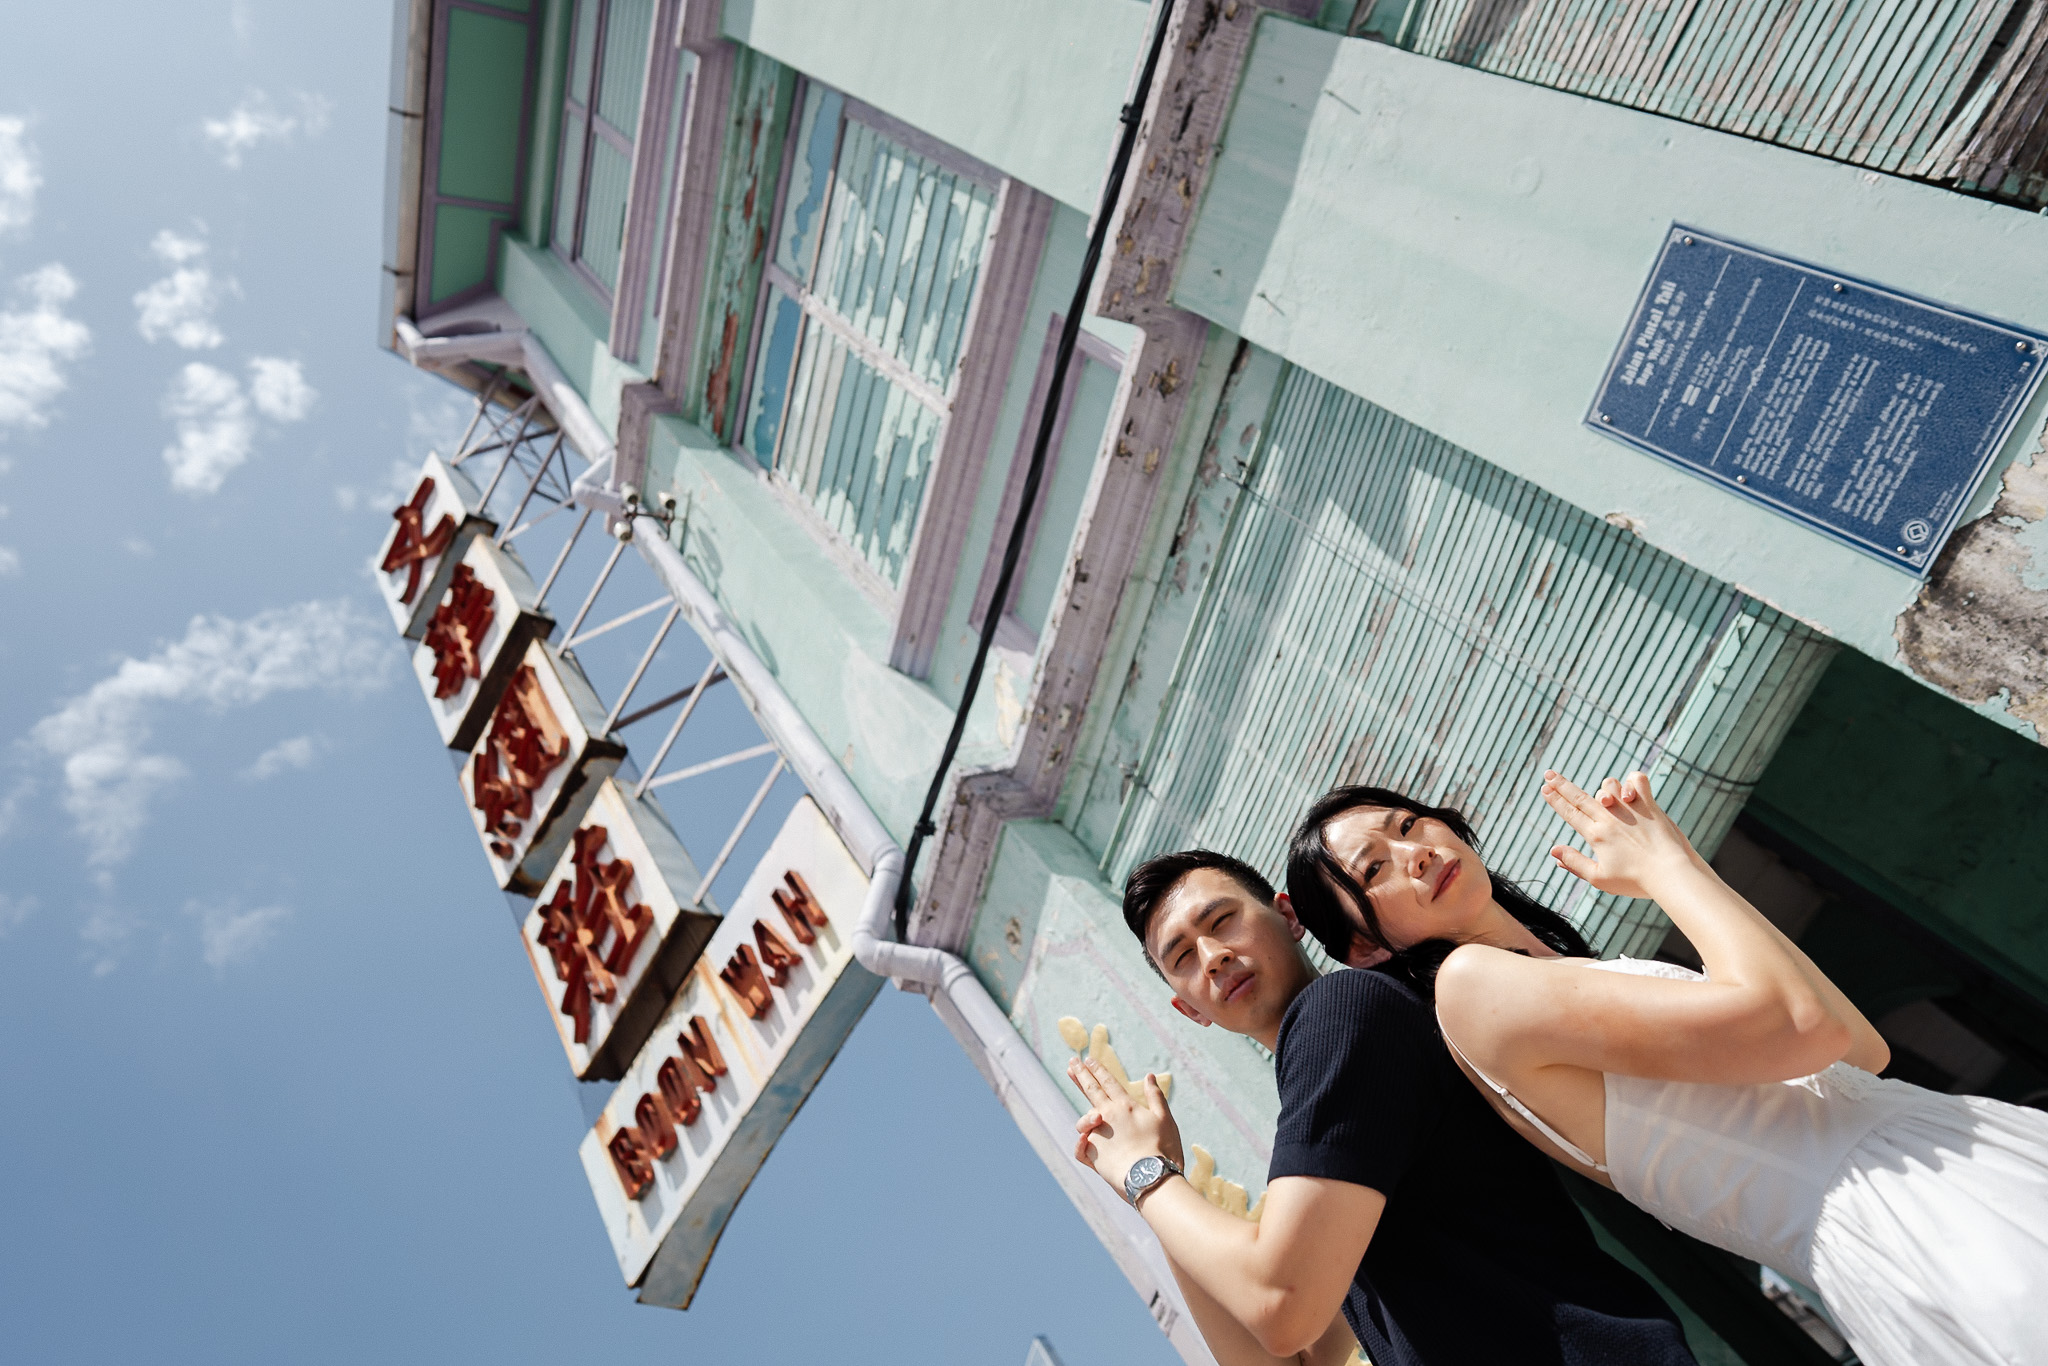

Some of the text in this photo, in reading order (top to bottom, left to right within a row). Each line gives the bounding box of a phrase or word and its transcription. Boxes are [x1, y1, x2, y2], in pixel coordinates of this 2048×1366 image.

[1619, 349, 1645, 384] Jalan
[1635, 307, 1664, 348] Pintal
[1654, 280, 1677, 305] Tali
[1646, 336, 1667, 361] Walk
[1667, 340, 1693, 384] HISTORICAL
[608, 870, 828, 1200] BOON WAH
